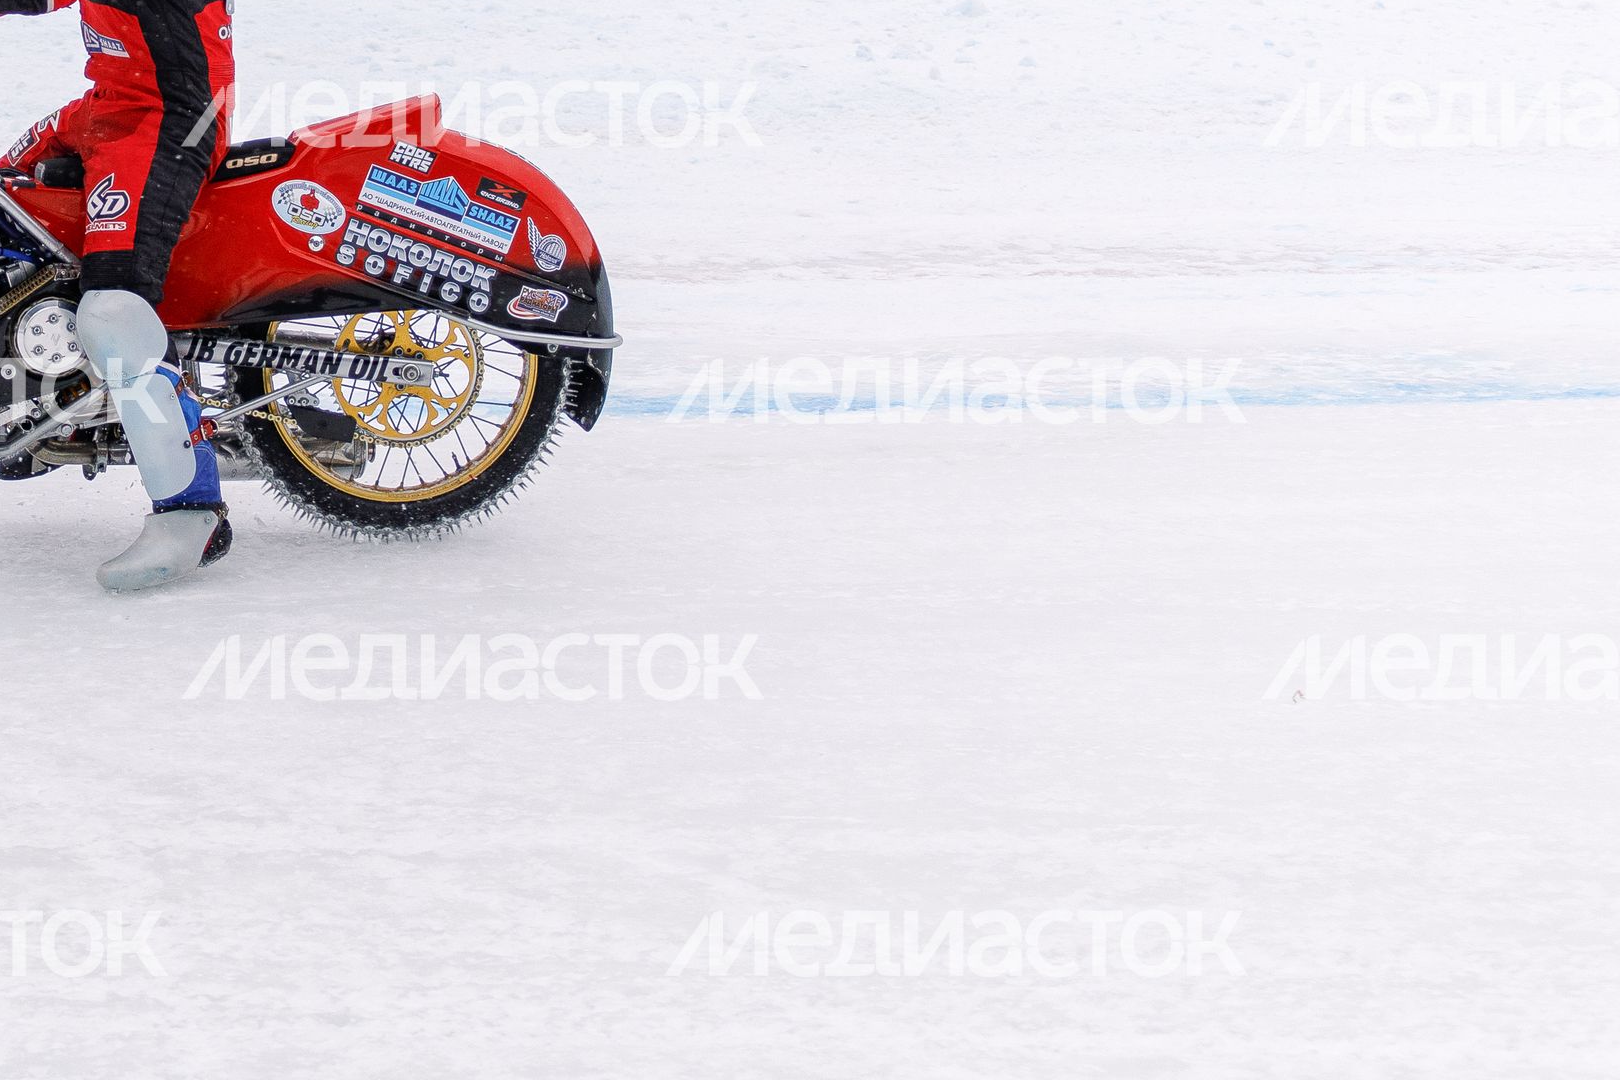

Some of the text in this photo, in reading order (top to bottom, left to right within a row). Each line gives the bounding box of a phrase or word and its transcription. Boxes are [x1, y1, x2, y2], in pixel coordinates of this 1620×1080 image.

[226, 153, 278, 169] OSO
[390, 151, 432, 173] MTRS
[394, 141, 436, 162] COOL
[370, 168, 418, 194] ШААЗ
[86, 222, 126, 231] ELMETS
[288, 203, 326, 227] OSO
[362, 192, 373, 200] АО
[425, 215, 481, 241] АВТОАГРЕГАТНЫЙ
[468, 206, 516, 230] SHAAZ
[343, 218, 497, 292] НОКОЛОК
[336, 244, 490, 313] SOFICO
[183, 335, 389, 382] JB GERMAN OIL
